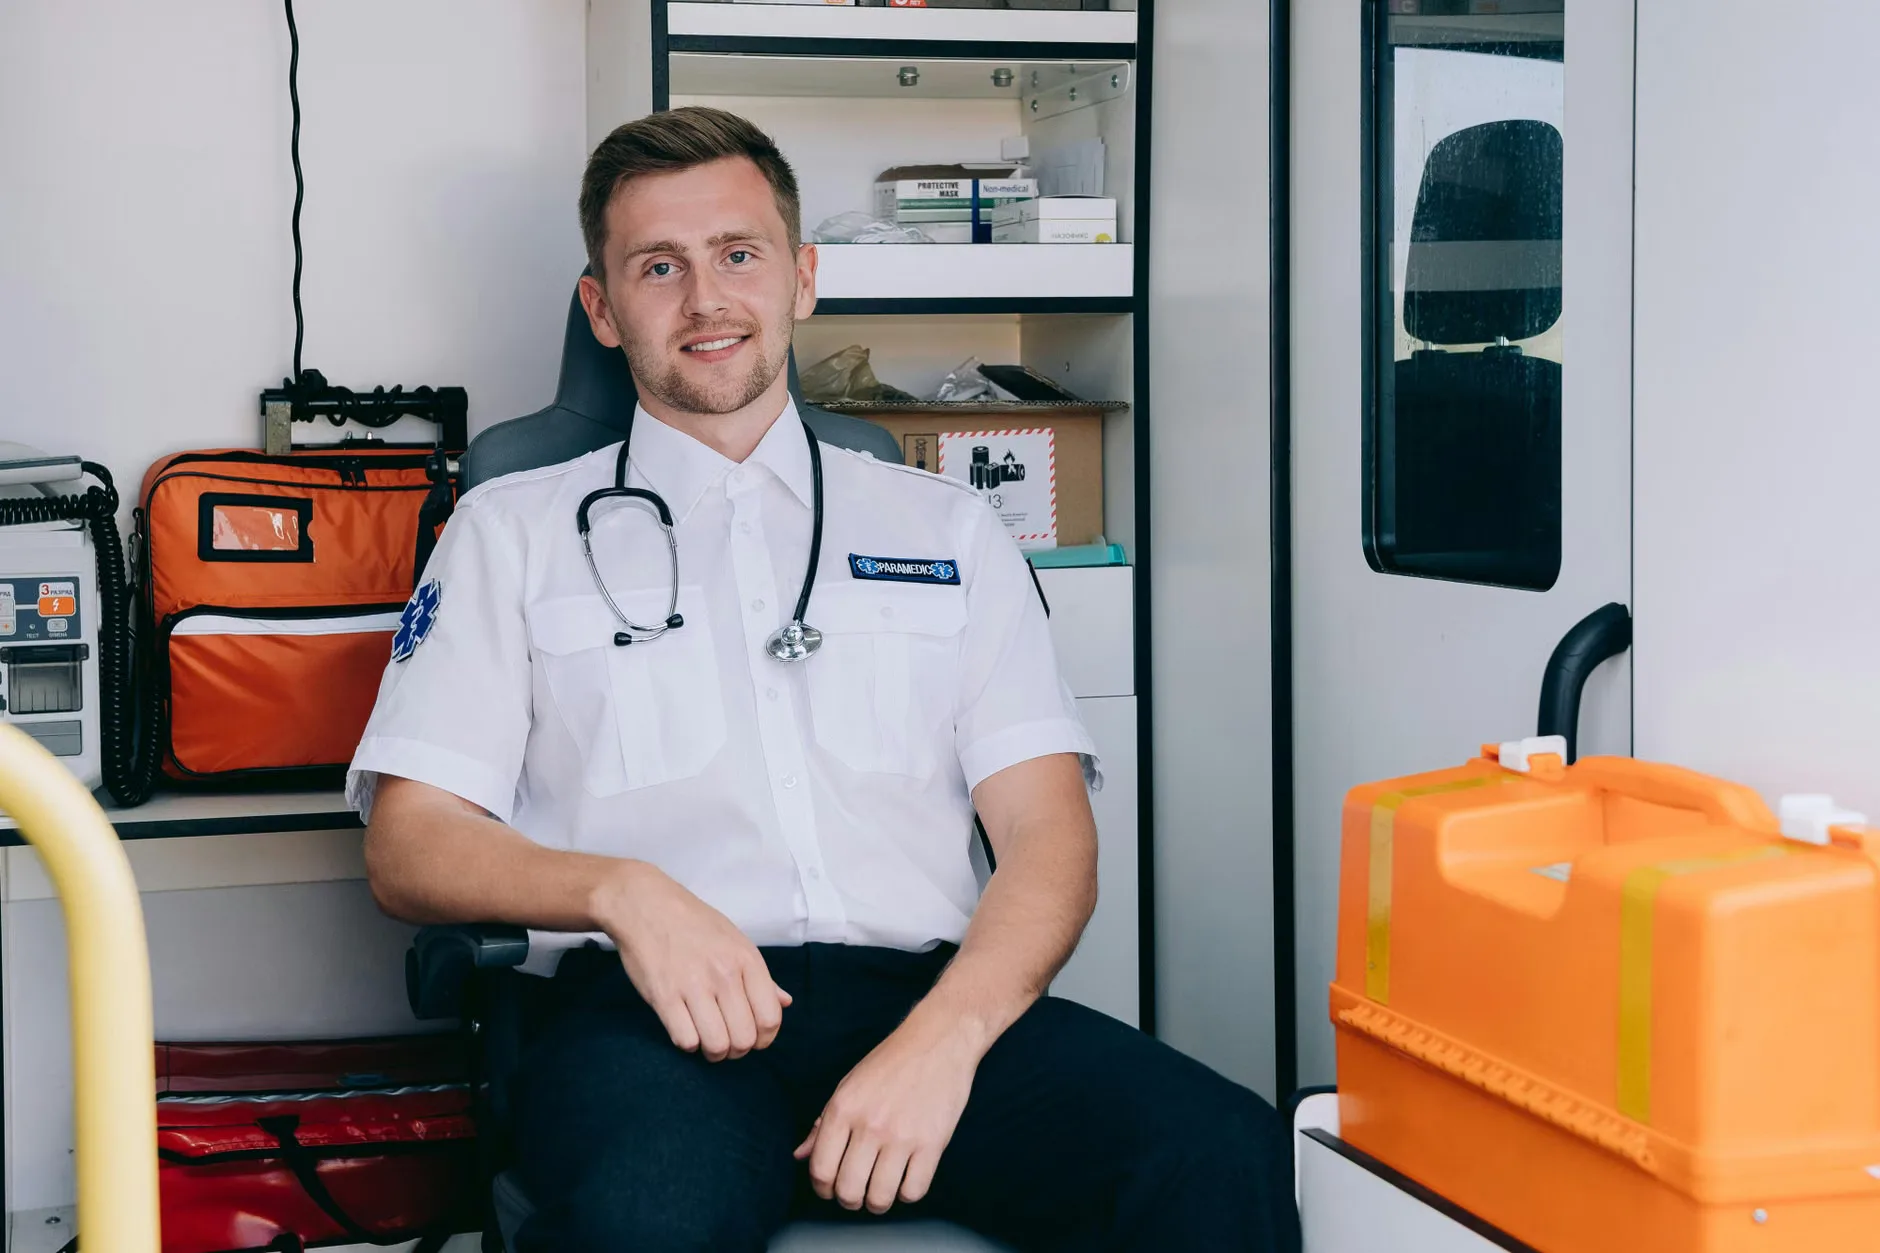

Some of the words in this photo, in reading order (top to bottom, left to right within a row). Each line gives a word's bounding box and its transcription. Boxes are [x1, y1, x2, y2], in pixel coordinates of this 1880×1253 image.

[917, 181, 959, 190] PROTECTIVE
[983, 183, 1029, 194] Non-medical
[878, 562, 932, 575] PARAMEDIC
[41, 584, 49, 595] 3
